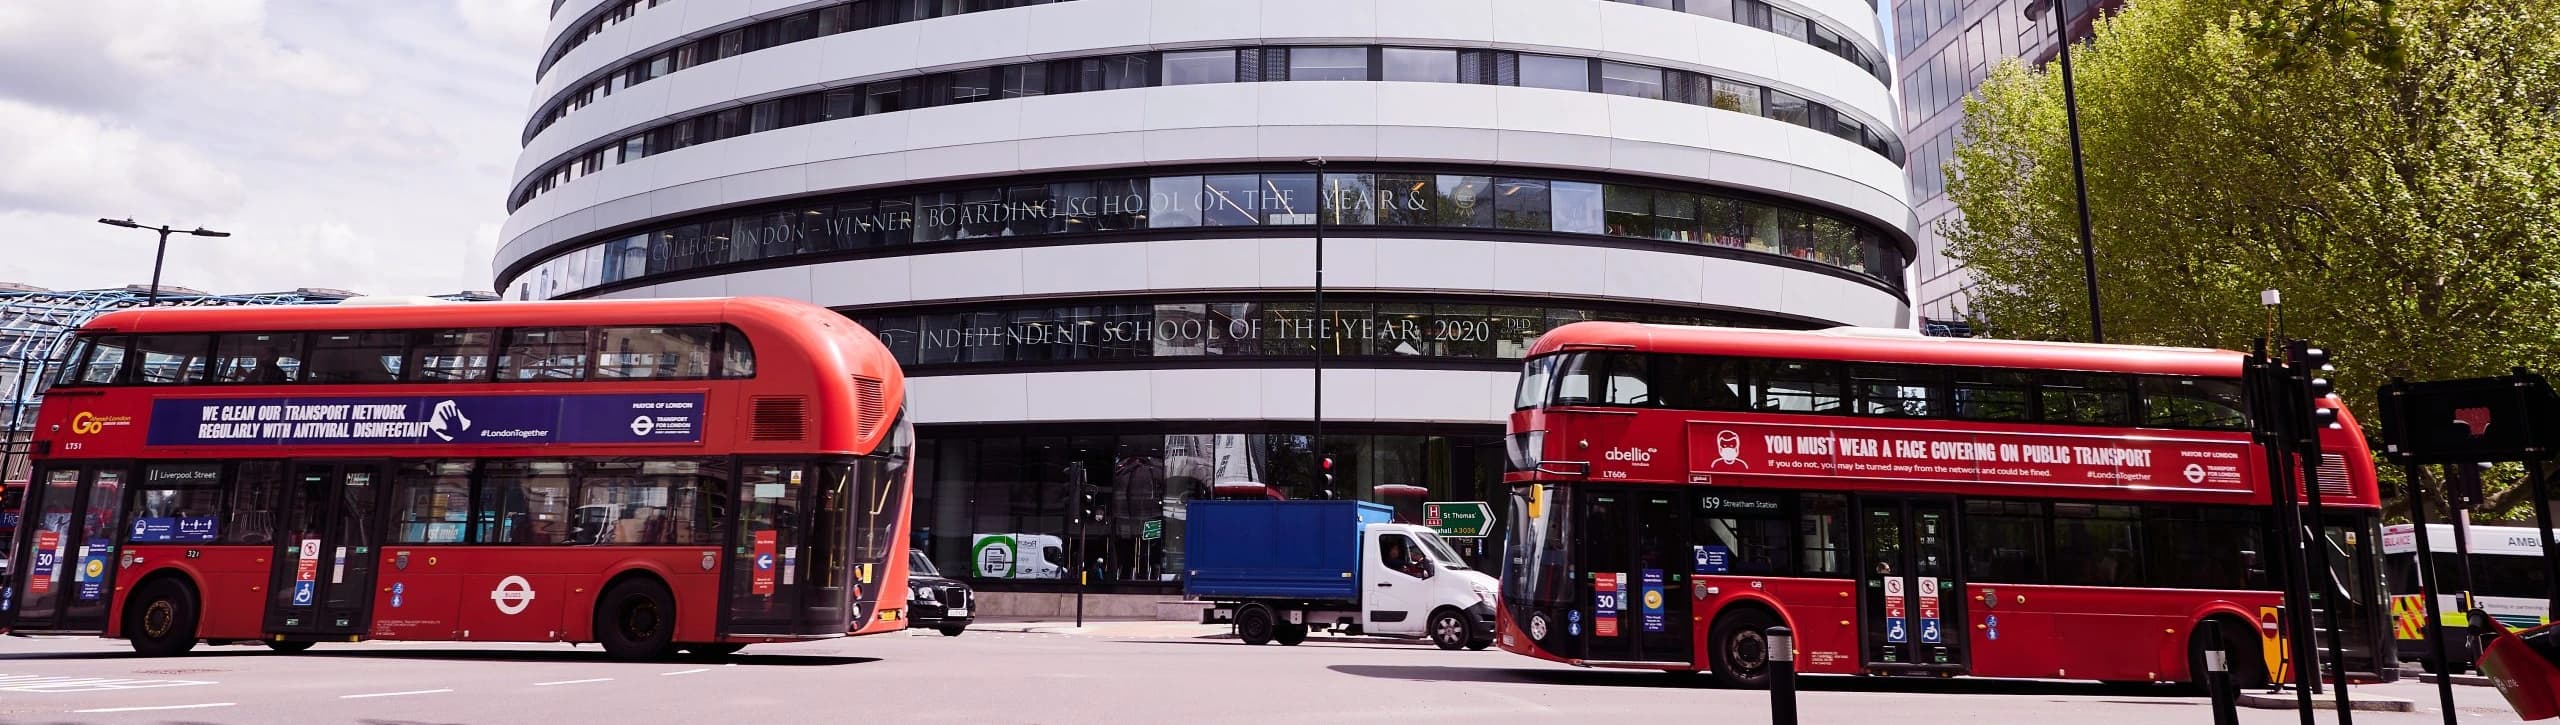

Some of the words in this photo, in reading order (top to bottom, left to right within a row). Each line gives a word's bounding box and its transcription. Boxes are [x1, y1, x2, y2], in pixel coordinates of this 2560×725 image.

[721, 222, 805, 250] LONDON
[929, 198, 1057, 228] BOARDING
[1070, 191, 1185, 217] SCHOOL
[1194, 190, 1229, 212] OF
[1243, 189, 1294, 211] THE
[1322, 189, 1398, 211] YEAR
[1407, 189, 1430, 211] &
[1507, 318, 1531, 329] DLD
[921, 322, 1090, 349] INDEPENDENT
[1103, 319, 1220, 342] SCHOOL
[1229, 318, 1262, 340] OF
[1275, 318, 1331, 339] THE
[1342, 318, 1419, 341] YEAR
[1435, 319, 1490, 342] 2020
[202, 405, 220, 421] WE
[221, 405, 256, 421] CLEAN
[258, 405, 282, 421] OUR
[285, 404, 351, 421] TRANSPORT
[352, 404, 408, 421] NETWORK
[73, 411, 102, 434] Go
[198, 422, 261, 439] REGULARLY
[263, 422, 291, 439] WITH
[293, 422, 350, 438] ANTIVIRAL
[353, 421, 430, 438] DISINFECTANT
[480, 429, 549, 438] #LondonTogether
[65, 442, 82, 450] LT51
[1764, 435, 1793, 455] YOU
[1797, 436, 1836, 456] MUST
[1839, 438, 1879, 458] WEAR
[1882, 439, 1892, 458] A
[1896, 439, 1928, 459] FACE
[1931, 441, 1996, 462] COVERING
[2000, 443, 2019, 463] ON
[2023, 444, 2071, 465] PUBLIC
[2073, 446, 2151, 467] TRANSPORT
[1605, 446, 1651, 462] abellio
[1775, 461, 1791, 469] you
[1792, 460, 1802, 468] do
[1821, 462, 1837, 470] you
[1838, 463, 1853, 471] may
[1866, 463, 1892, 471] turned
[1893, 465, 1913, 473] away
[1914, 465, 1933, 473] from
[1934, 465, 1948, 473] the
[1949, 466, 1980, 474] network
[1981, 467, 1996, 475] and
[1997, 467, 2018, 476] could
[2020, 468, 2030, 476] be
[160, 471, 192, 479] Liverpool
[194, 471, 217, 479] Street
[1603, 471, 1627, 479] LT606
[1702, 497, 1720, 509] 159
[1723, 500, 1755, 508] Streatham
[1756, 501, 1778, 509] Station
[1430, 506, 1438, 517] H
[37, 553, 53, 566] 30
[1597, 595, 1614, 608] 30
